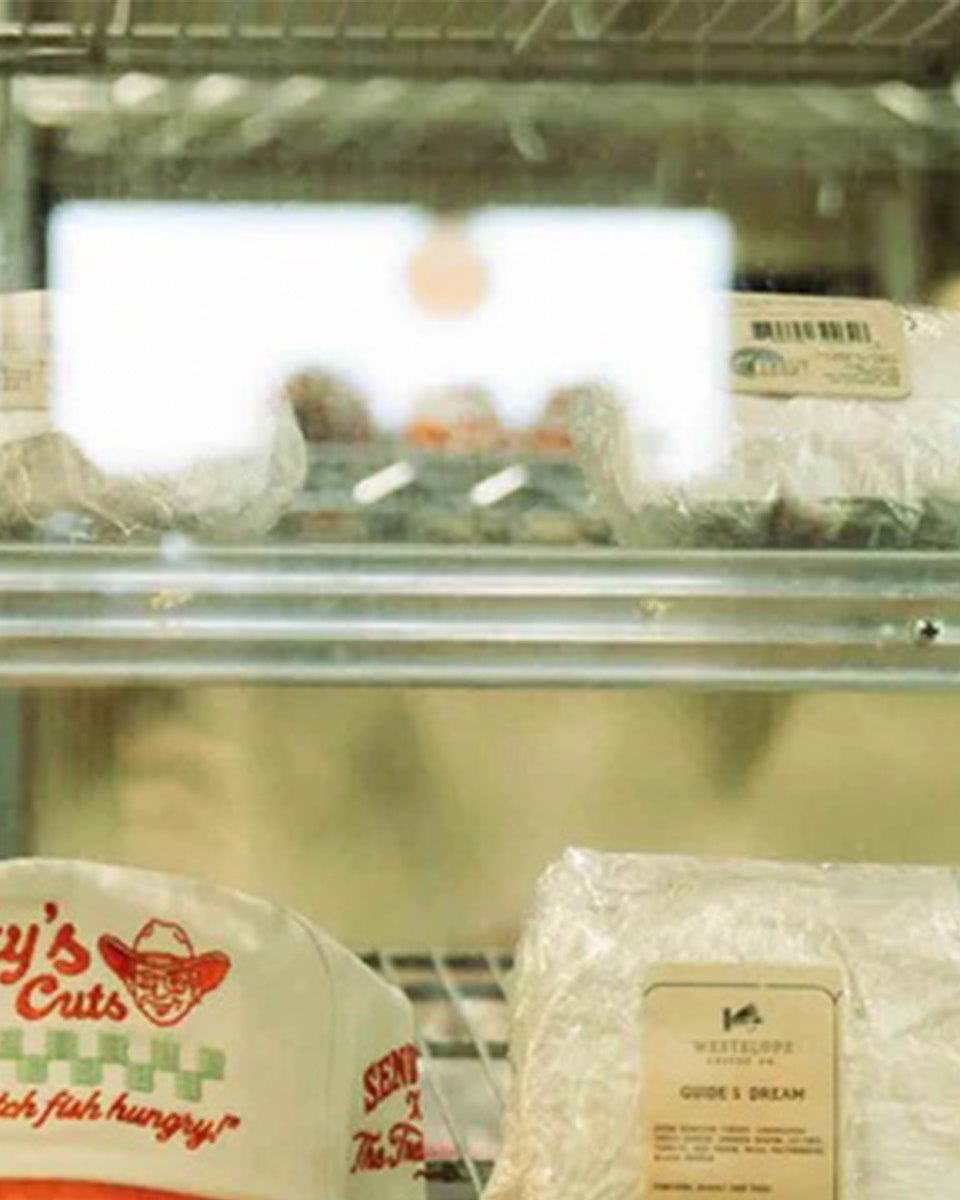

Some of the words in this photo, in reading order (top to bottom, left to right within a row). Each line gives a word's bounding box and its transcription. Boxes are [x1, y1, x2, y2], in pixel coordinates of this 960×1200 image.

[15, 973, 129, 1022] Cuts
[749, 1087, 806, 1101] DREAM
[32, 1089, 102, 1129] fish
[106, 1091, 241, 1151] hungry!"
